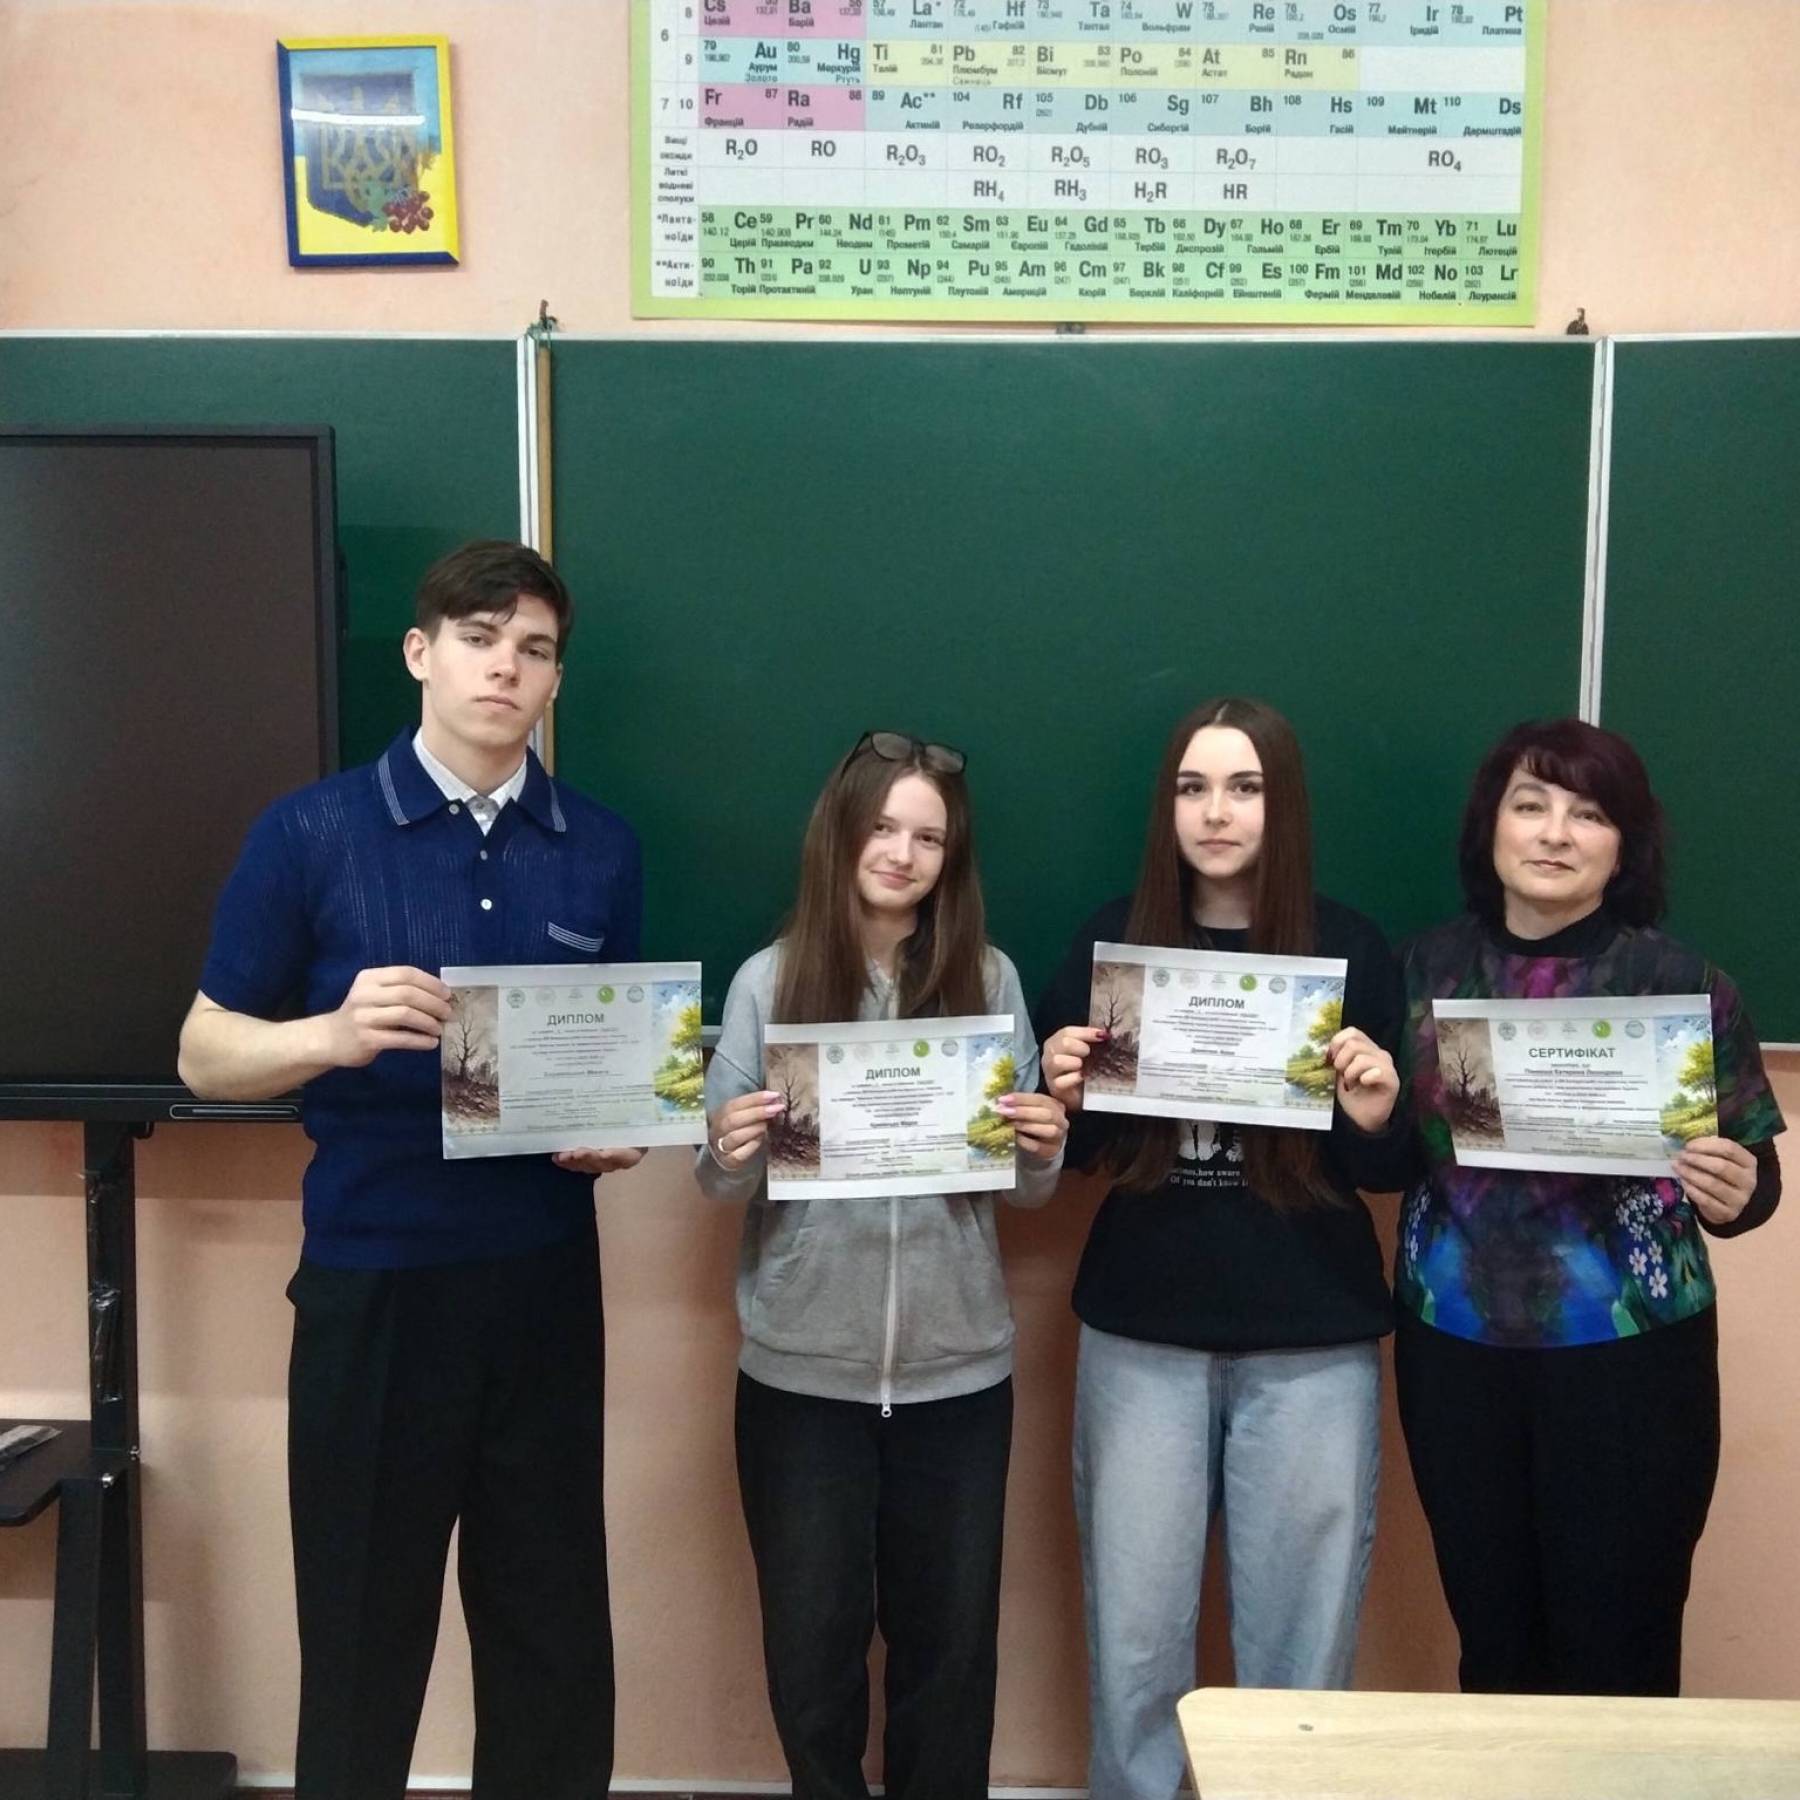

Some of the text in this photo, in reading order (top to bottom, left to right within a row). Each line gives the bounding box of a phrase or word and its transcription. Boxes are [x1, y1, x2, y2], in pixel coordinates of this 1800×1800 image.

[704, 0, 726, 12] Cs
[790, 0, 811, 14] Ba
[1006, 0, 1025, 16] Hf
[1090, 2, 1110, 18] Ta
[1121, 1, 1132, 10] 74
[1176, 3, 1193, 18] W
[1253, 4, 1275, 19] Re
[1369, 3, 1380, 12] 77
[1451, 5, 1463, 15] 78
[685, 7, 692, 18] 8
[1334, 5, 1357, 21] Os
[1427, 6, 1439, 21] Ir
[1505, 7, 1522, 22] Pt
[661, 30, 669, 42] 6
[704, 41, 717, 50] 79
[755, 43, 777, 58] Au
[787, 42, 800, 51] 80
[685, 54, 692, 64] 9
[838, 44, 860, 65] Hg
[953, 46, 975, 61] Pb
[1037, 46, 1054, 62] Bi
[1121, 48, 1142, 63] Po
[1203, 50, 1220, 64] At
[1285, 50, 1307, 65] Rn
[749, 63, 777, 72] Аурум
[705, 89, 722, 105] Fr
[765, 89, 778, 98] 87
[788, 90, 810, 106] Ra
[872, 91, 884, 100] 89
[953, 92, 970, 101] 104
[1036, 93, 1053, 102] 105
[1119, 93, 1136, 103] 106
[1201, 94, 1219, 104] 107
[1284, 95, 1301, 105] 108
[662, 98, 669, 109] 7
[680, 100, 693, 109] 10
[1003, 93, 1023, 109] Rf
[1085, 95, 1108, 110] Db
[1167, 95, 1189, 115] Sg
[1251, 97, 1272, 112] Bh
[1331, 97, 1352, 112] Hs
[1367, 96, 1384, 106] 109
[1414, 98, 1437, 114] Mt
[1445, 97, 1461, 106] 110
[1500, 99, 1521, 114] Ds
[811, 141, 836, 156] RO
[1223, 184, 1247, 199] HR
[702, 212, 714, 222] 58
[735, 212, 757, 228] Ce
[760, 213, 773, 223] 59
[796, 213, 814, 228] Pr
[850, 214, 873, 230] Nd
[879, 216, 890, 225] 61
[905, 214, 930, 230] Pm
[937, 216, 949, 225] 62
[963, 215, 990, 231] Sm
[996, 217, 1008, 226] 63
[1055, 217, 1067, 226] 64
[1114, 218, 1126, 227] 65
[1028, 216, 1048, 232] Eu
[1084, 217, 1108, 232] Gd
[1144, 217, 1165, 233] Tb
[1204, 218, 1226, 237] Dy
[1231, 219, 1243, 229] 67
[1261, 219, 1284, 235] Ho
[1290, 220, 1302, 229] 68
[1322, 220, 1340, 235] Er
[1350, 220, 1362, 230] 69
[1377, 220, 1401, 235] Tm
[1407, 221, 1420, 230] 70
[1435, 220, 1456, 235] Yb
[1466, 222, 1478, 231] 71
[1497, 220, 1517, 236] Lu
[664, 232, 694, 241] ноїди
[702, 258, 714, 268] 90
[735, 258, 755, 273] Th
[761, 259, 773, 268] 91
[792, 259, 813, 274] Pa
[819, 260, 831, 269] 92
[859, 259, 871, 275] U
[877, 260, 890, 269] 93
[908, 260, 931, 278] Np
[937, 261, 949, 270] 94
[969, 260, 989, 276] Pu
[995, 262, 1007, 271] 95
[1019, 262, 1046, 276] Am
[1055, 262, 1067, 272] 96
[1079, 261, 1106, 277] Cm
[1113, 263, 1125, 272] 97
[1144, 262, 1165, 277] Bk
[1172, 263, 1185, 273] 98
[1229, 264, 1242, 273] 99
[1290, 264, 1308, 273] 100
[1206, 262, 1225, 278] Cf
[1262, 263, 1282, 279] Es
[1316, 264, 1340, 279] Fm
[1349, 266, 1366, 275] 101
[1377, 264, 1402, 280] Md
[1408, 265, 1425, 275] 102
[1435, 265, 1457, 280] No
[1466, 266, 1483, 275] 103
[1501, 265, 1518, 280] Lr
[665, 278, 694, 287] ноїди
[851, 287, 873, 296] Уран
[1189, 997, 1244, 1008] ДИПЛОМ
[547, 1013, 604, 1026] ДИПЛОМ
[1528, 1048, 1616, 1058] СЕРТИФІКАТ
[866, 1067, 920, 1080] ДИПЛОМ
